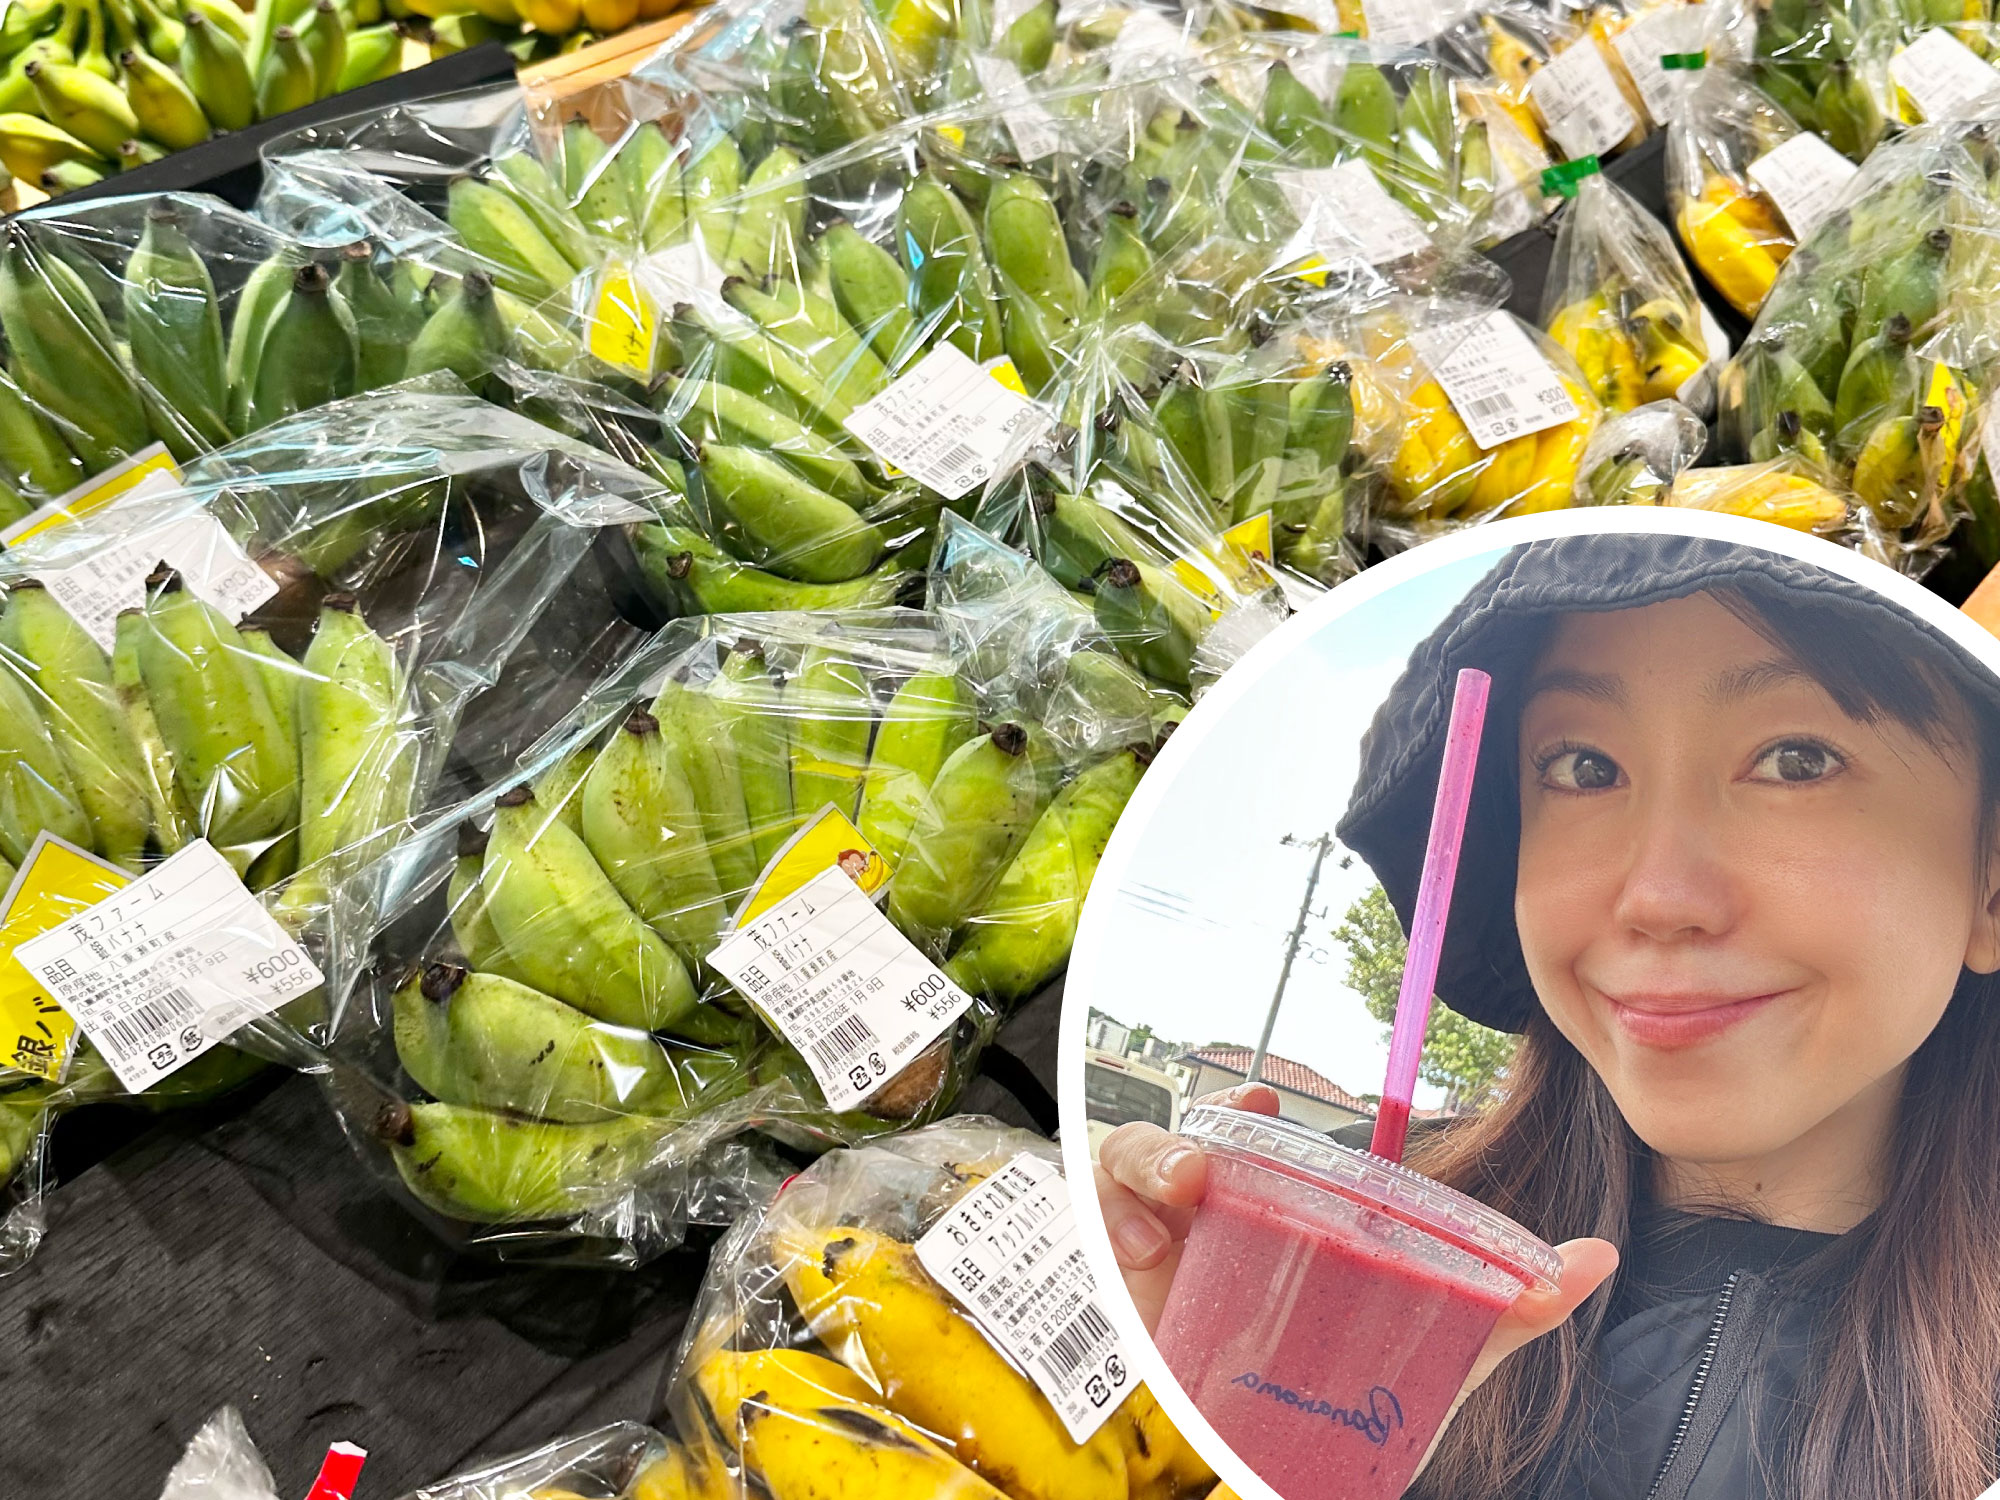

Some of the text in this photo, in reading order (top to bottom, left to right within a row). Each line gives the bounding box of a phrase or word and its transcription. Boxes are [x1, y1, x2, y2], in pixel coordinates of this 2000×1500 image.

[1535, 385, 1566, 405] ¥300
[67, 883, 165, 945] 茂ファーム
[745, 897, 816, 951] 茂ファーム
[41, 957, 77, 985] 品目
[58, 968, 103, 997] 原産地
[242, 945, 301, 988] ¥600
[270, 965, 313, 997] ¥556
[738, 964, 771, 993] 品目
[760, 979, 793, 1007] 原産地
[898, 971, 947, 1013] ¥600
[926, 989, 962, 1021] ¥556
[950, 1191, 1056, 1293] 品目 アップルバナナ
[976, 1273, 1013, 1310] 原産地
[989, 1277, 1034, 1321] 南の駅やえせ
